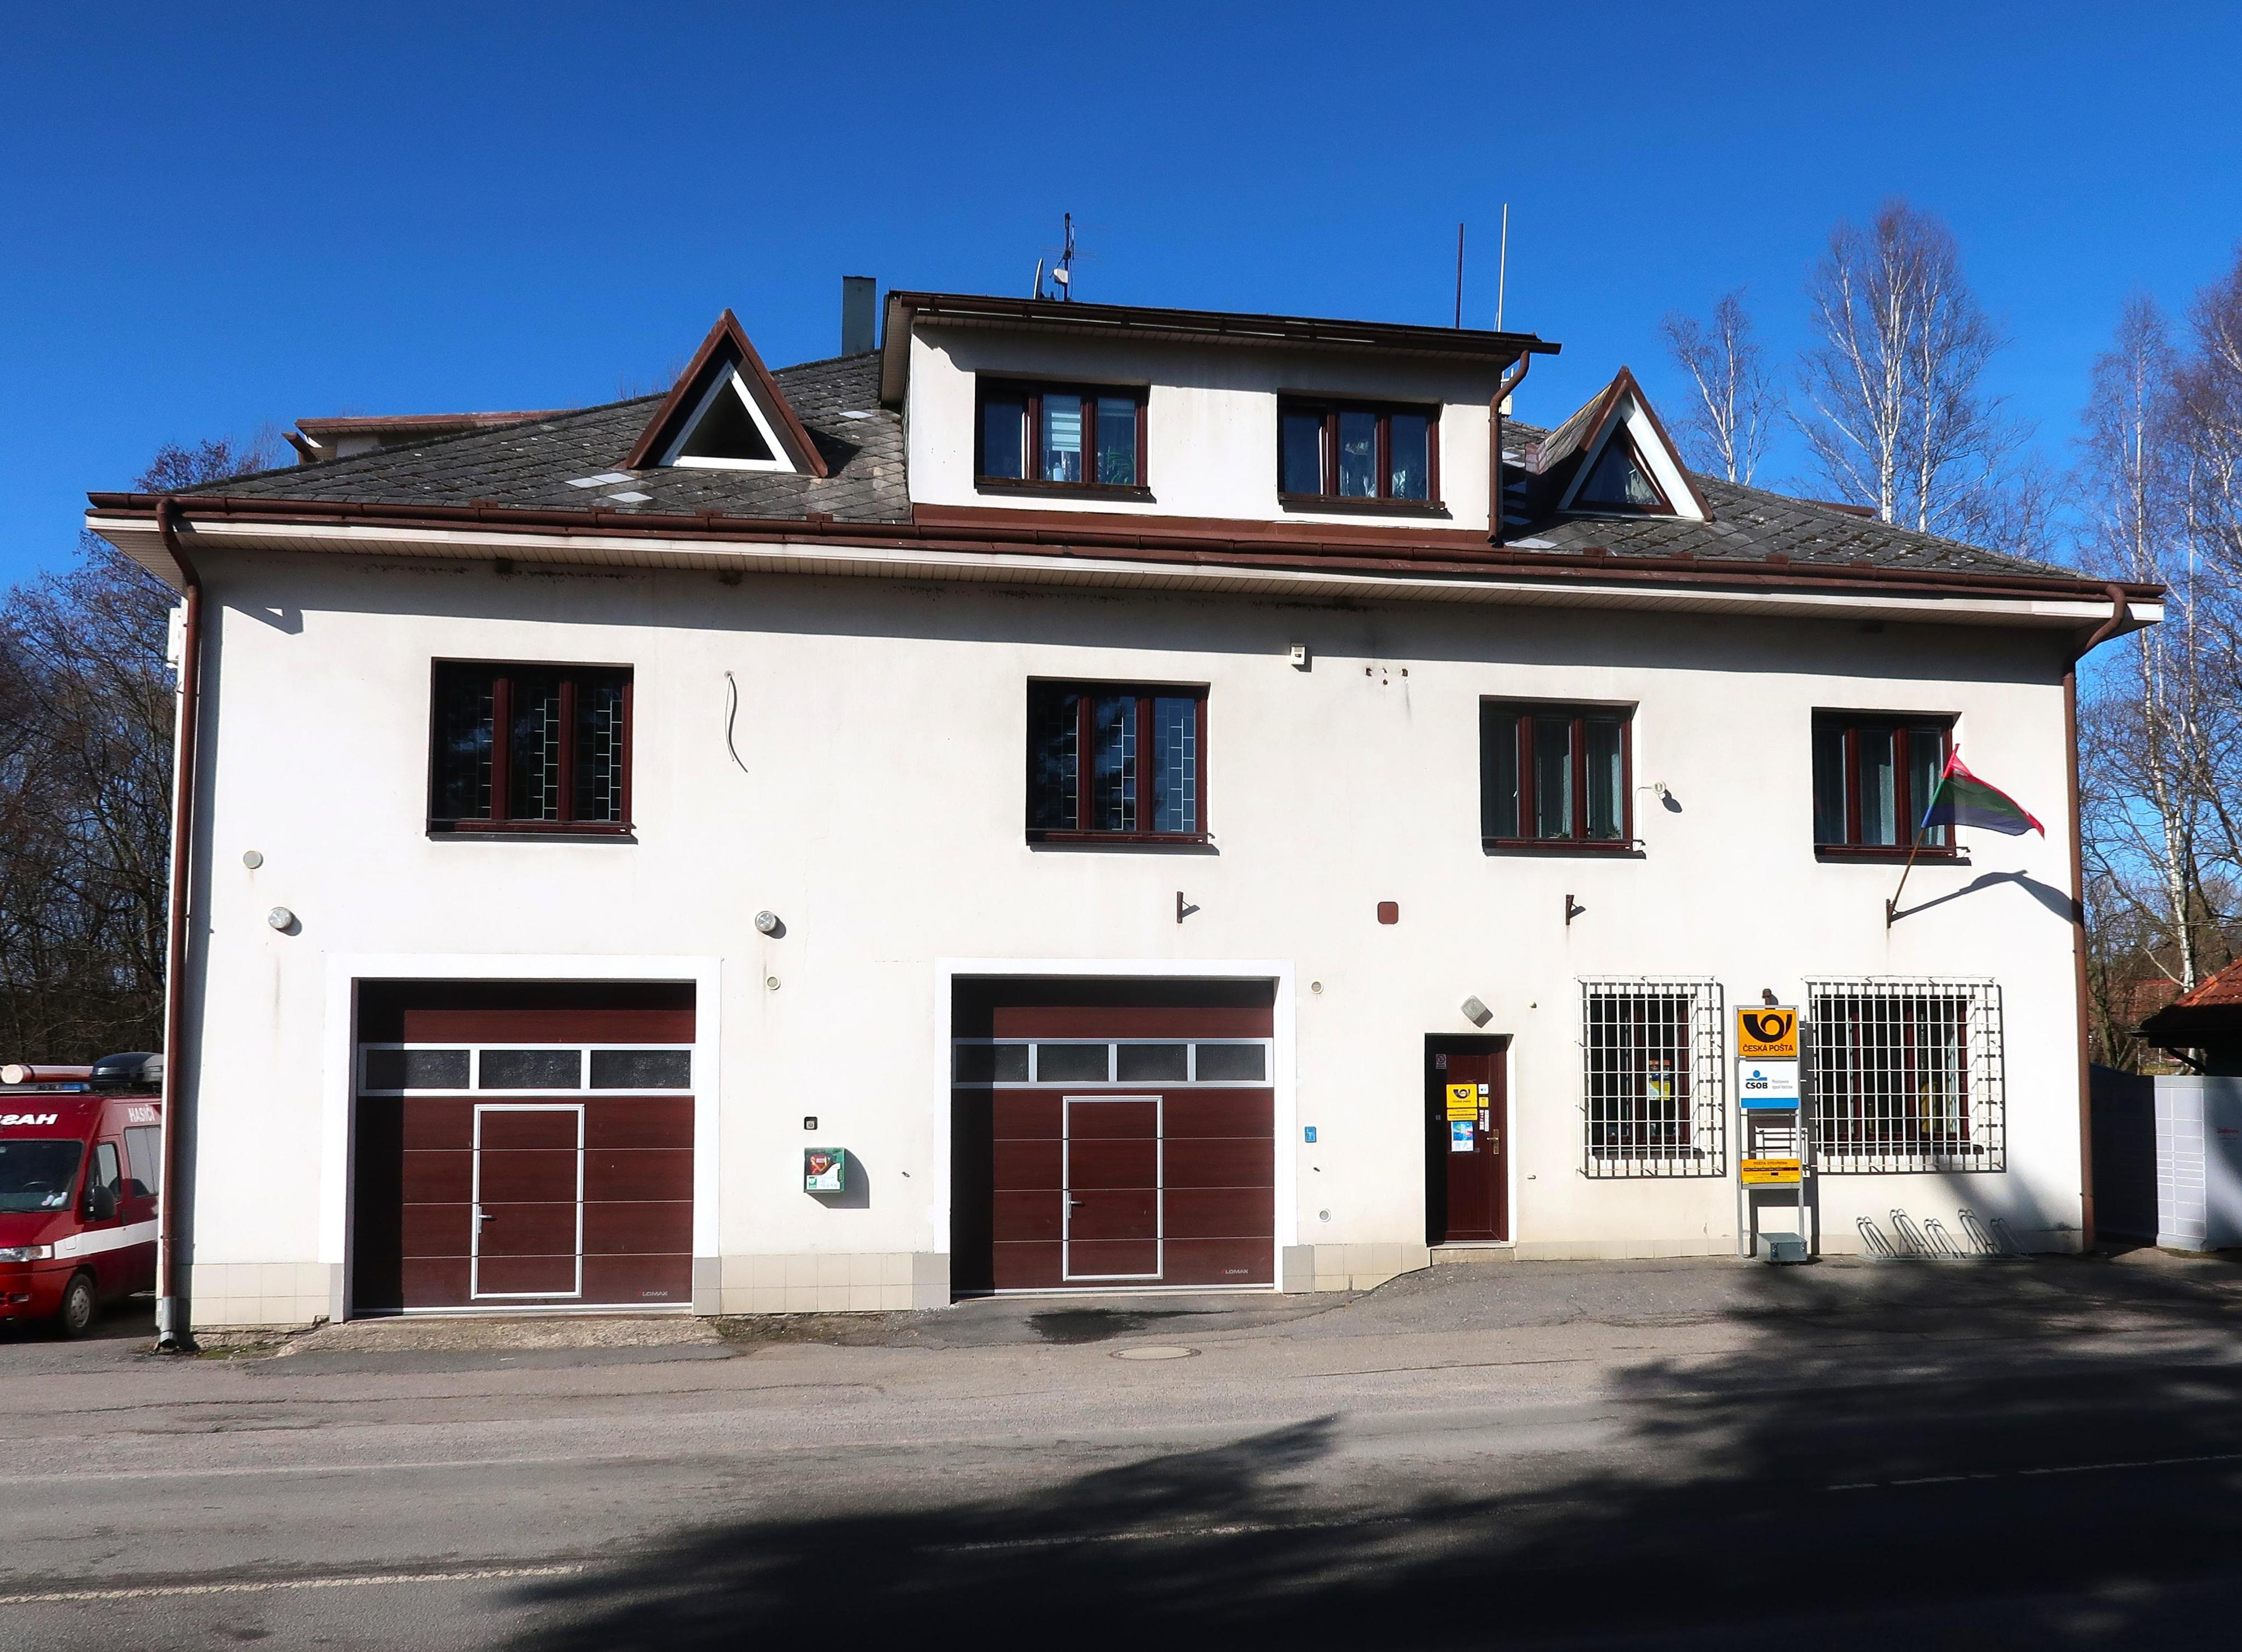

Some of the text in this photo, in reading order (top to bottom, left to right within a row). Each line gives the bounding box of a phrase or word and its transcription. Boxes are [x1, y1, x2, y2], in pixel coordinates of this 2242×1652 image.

[1743, 1043, 1794, 1052] ČESKÁ POŠTA
[127, 1103, 155, 1122] HASIČI
